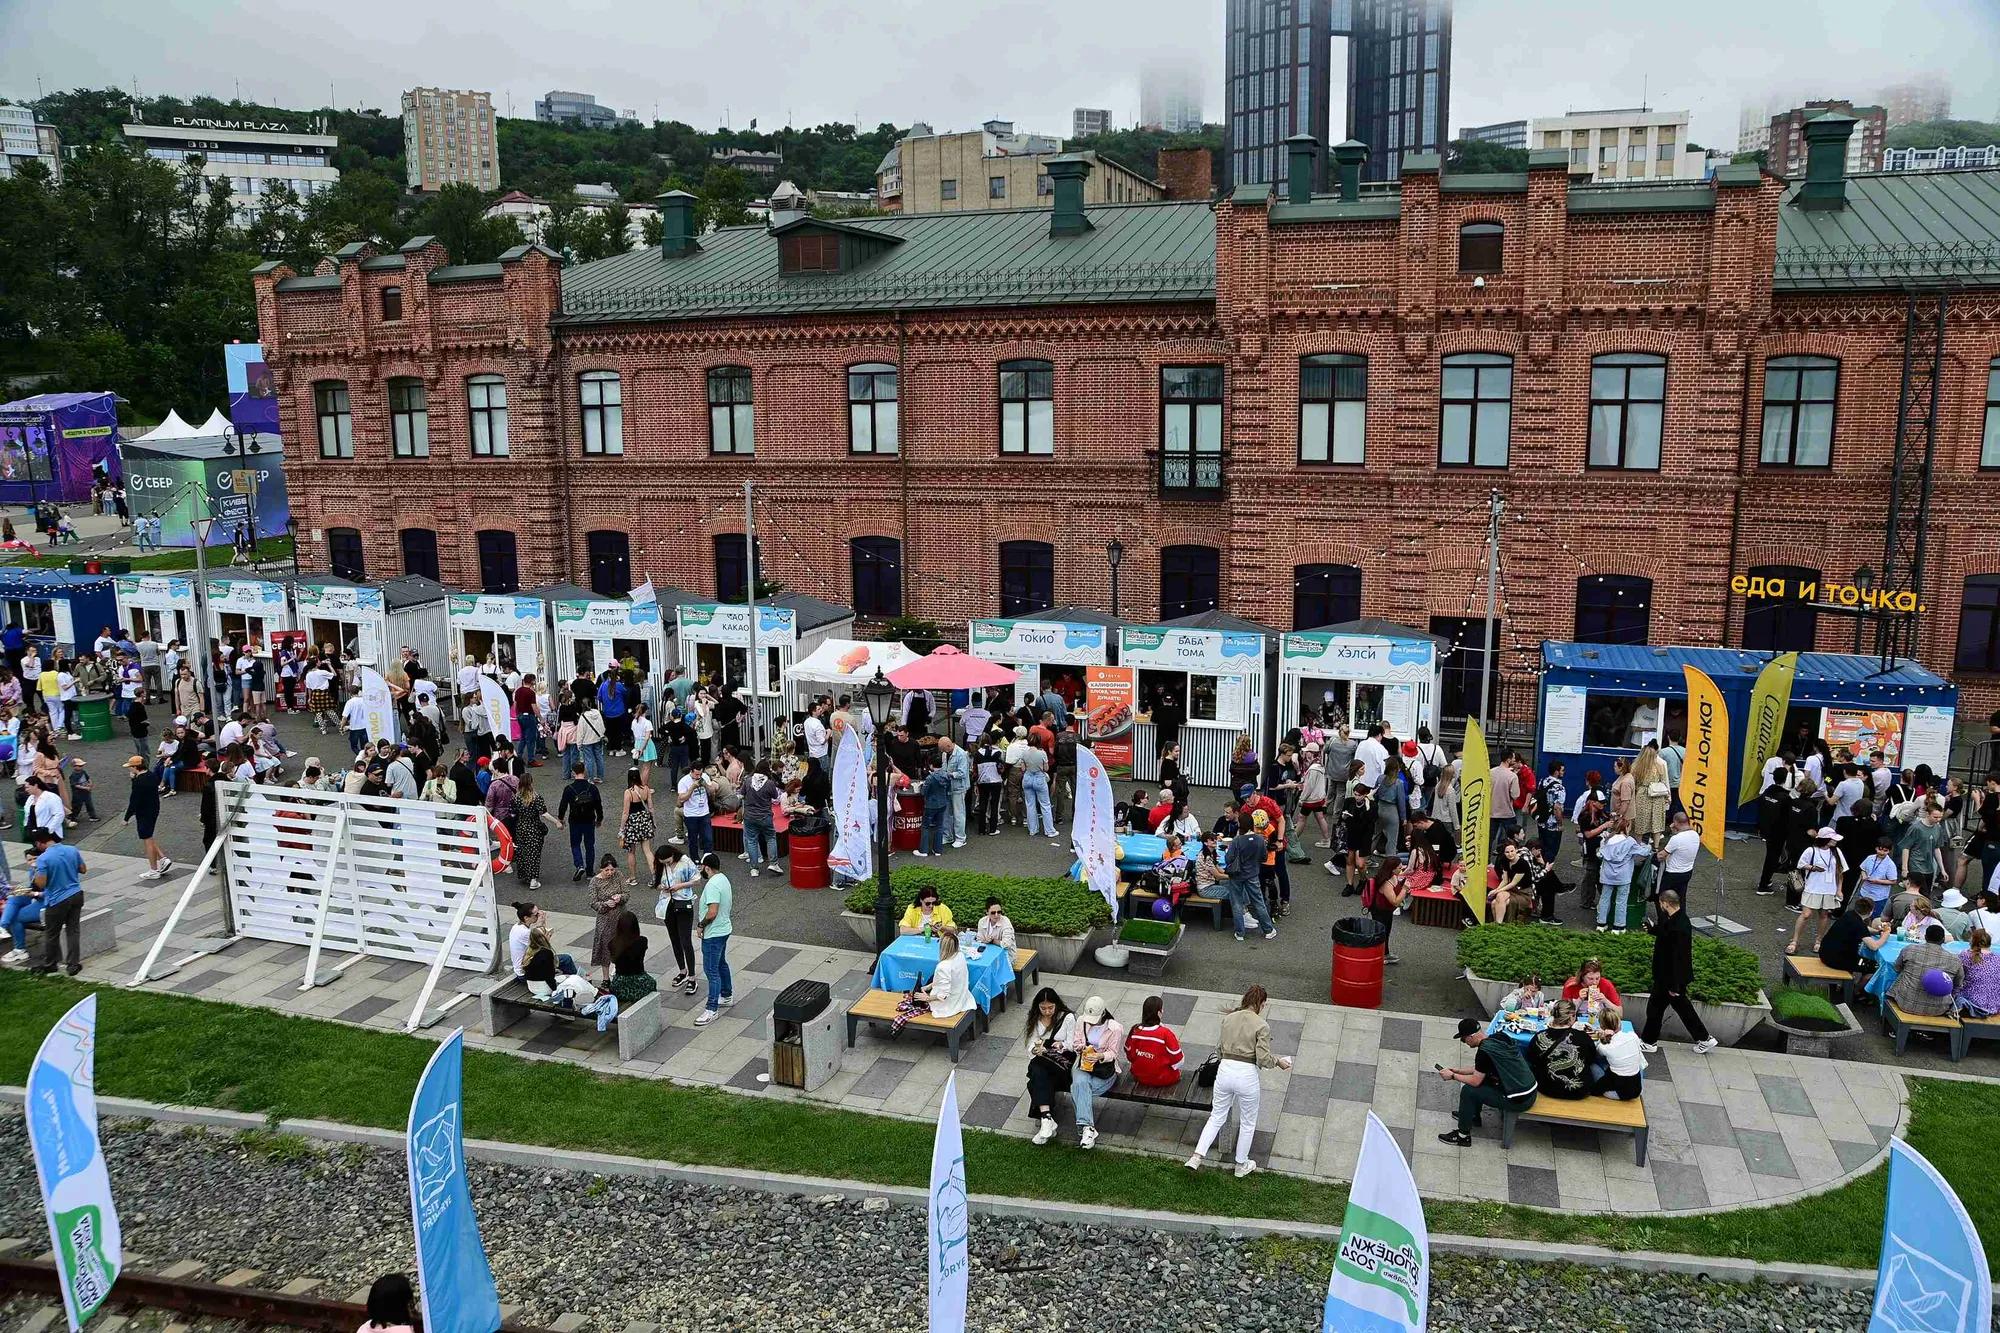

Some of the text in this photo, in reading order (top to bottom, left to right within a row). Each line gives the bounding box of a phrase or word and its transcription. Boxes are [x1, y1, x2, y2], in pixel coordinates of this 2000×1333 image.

[173, 117, 289, 131] PLATINUM PLAZA
[145, 477, 173, 488] СБЕР
[1731, 575, 1926, 612] еда и точка.
[236, 596, 255, 604] ПАТИО
[484, 606, 505, 615] ЗУМА
[594, 608, 620, 616] ОМЛЕТ
[590, 618, 625, 627] СТАНЦИЯ
[722, 624, 750, 632] КАКАО
[1019, 634, 1055, 644] ТОКИО
[1178, 637, 1204, 646] БАБА
[272, 642, 306, 650] СЕРЫ
[1177, 648, 1205, 658] ТОМА
[1337, 649, 1376, 660] ХЭЛСИ
[1756, 694, 1781, 764] Cantina
[422, 1199, 440, 1217] ISIT
